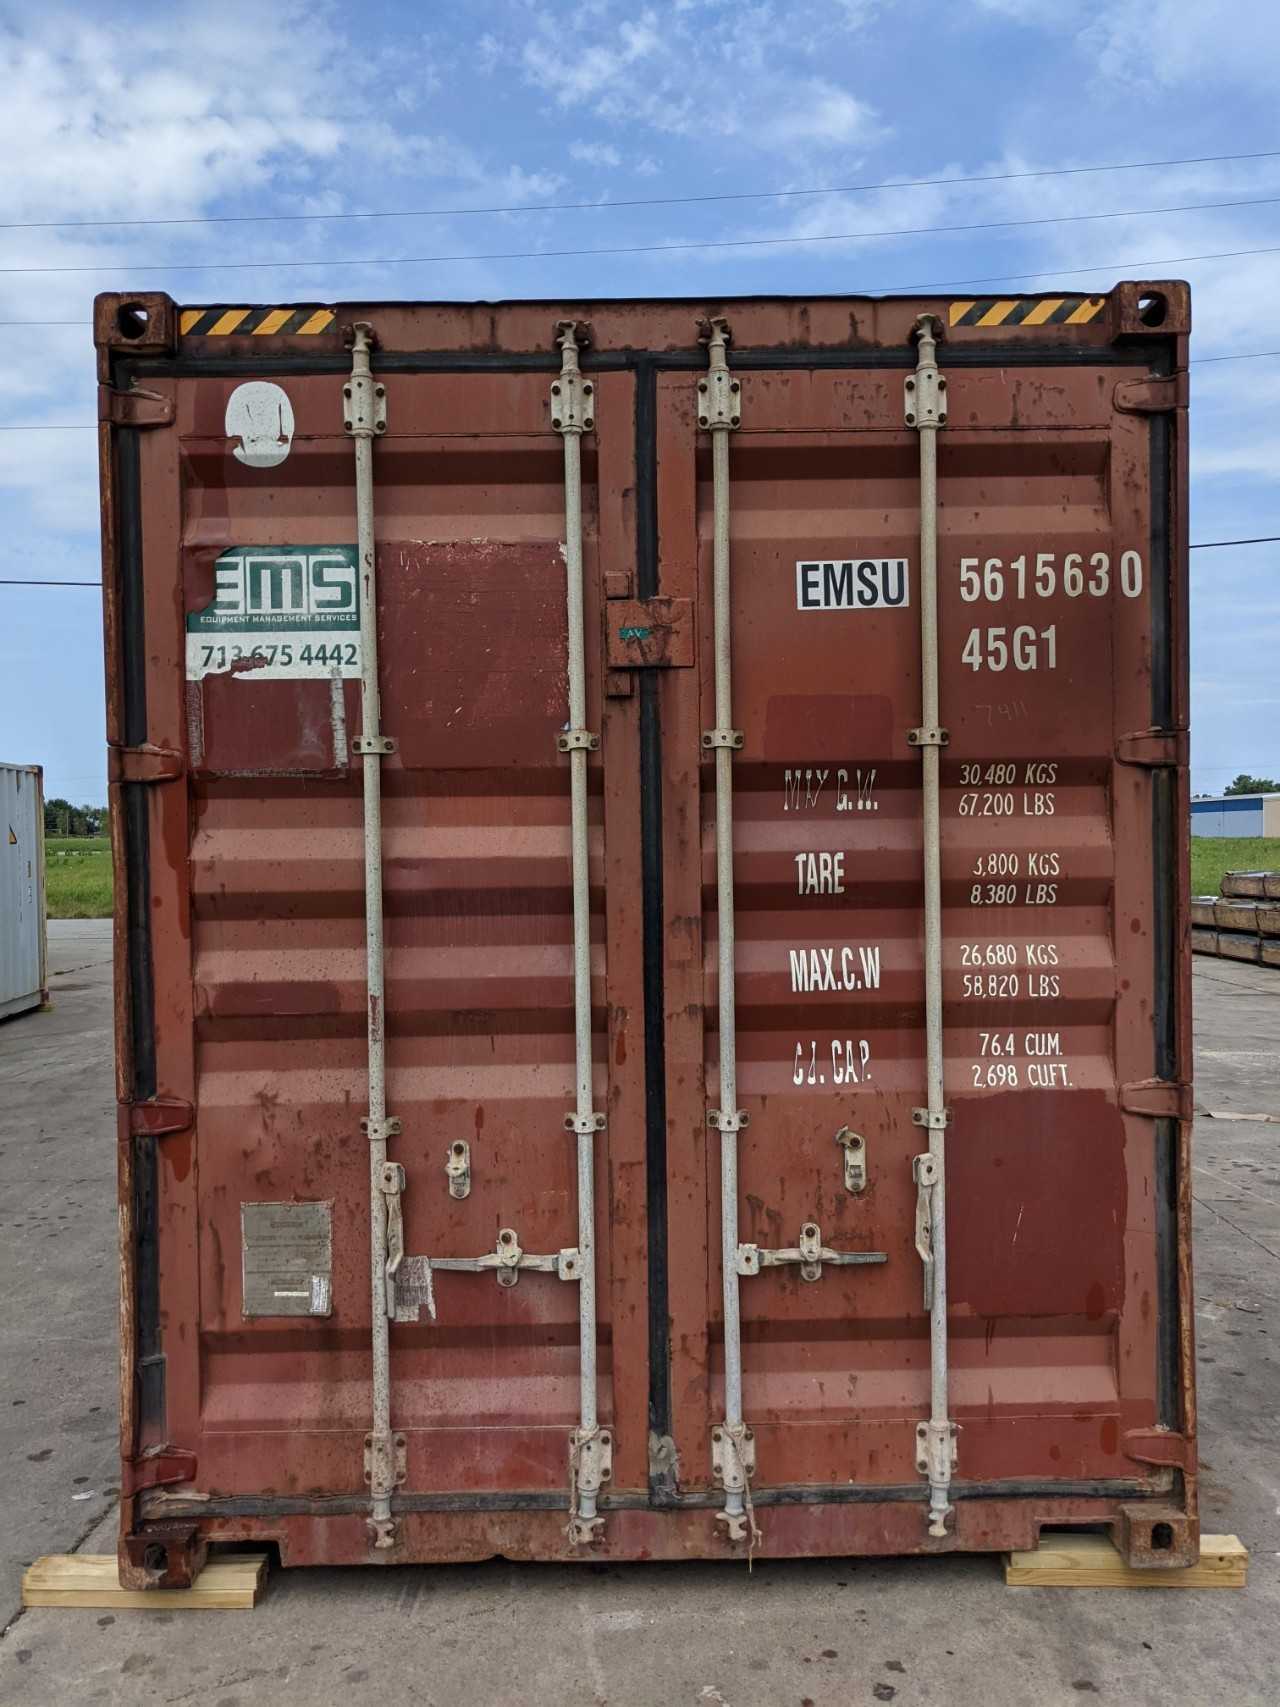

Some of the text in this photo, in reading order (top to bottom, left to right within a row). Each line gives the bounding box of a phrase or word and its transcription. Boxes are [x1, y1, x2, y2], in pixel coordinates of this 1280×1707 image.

[801, 561, 905, 608] EMSU
[200, 614, 357, 624] EQUIPMENT MANAGEMENT SERVICES
[300, 643, 358, 666] 4442
[961, 624, 1057, 672] 45G1
[959, 763, 1058, 786] 30,480 KGS
[958, 792, 1055, 816] 67,200 LBS
[794, 851, 845, 895] TARE
[972, 852, 1060, 876] 3,800 KGS
[970, 883, 1058, 905] 8,380 LBS
[960, 943, 1058, 966] 26,680 KGS
[963, 974, 1060, 998] 58,820 LBS
[979, 1032, 1015, 1056] 76.4
[971, 1064, 1018, 1088] 2,698
